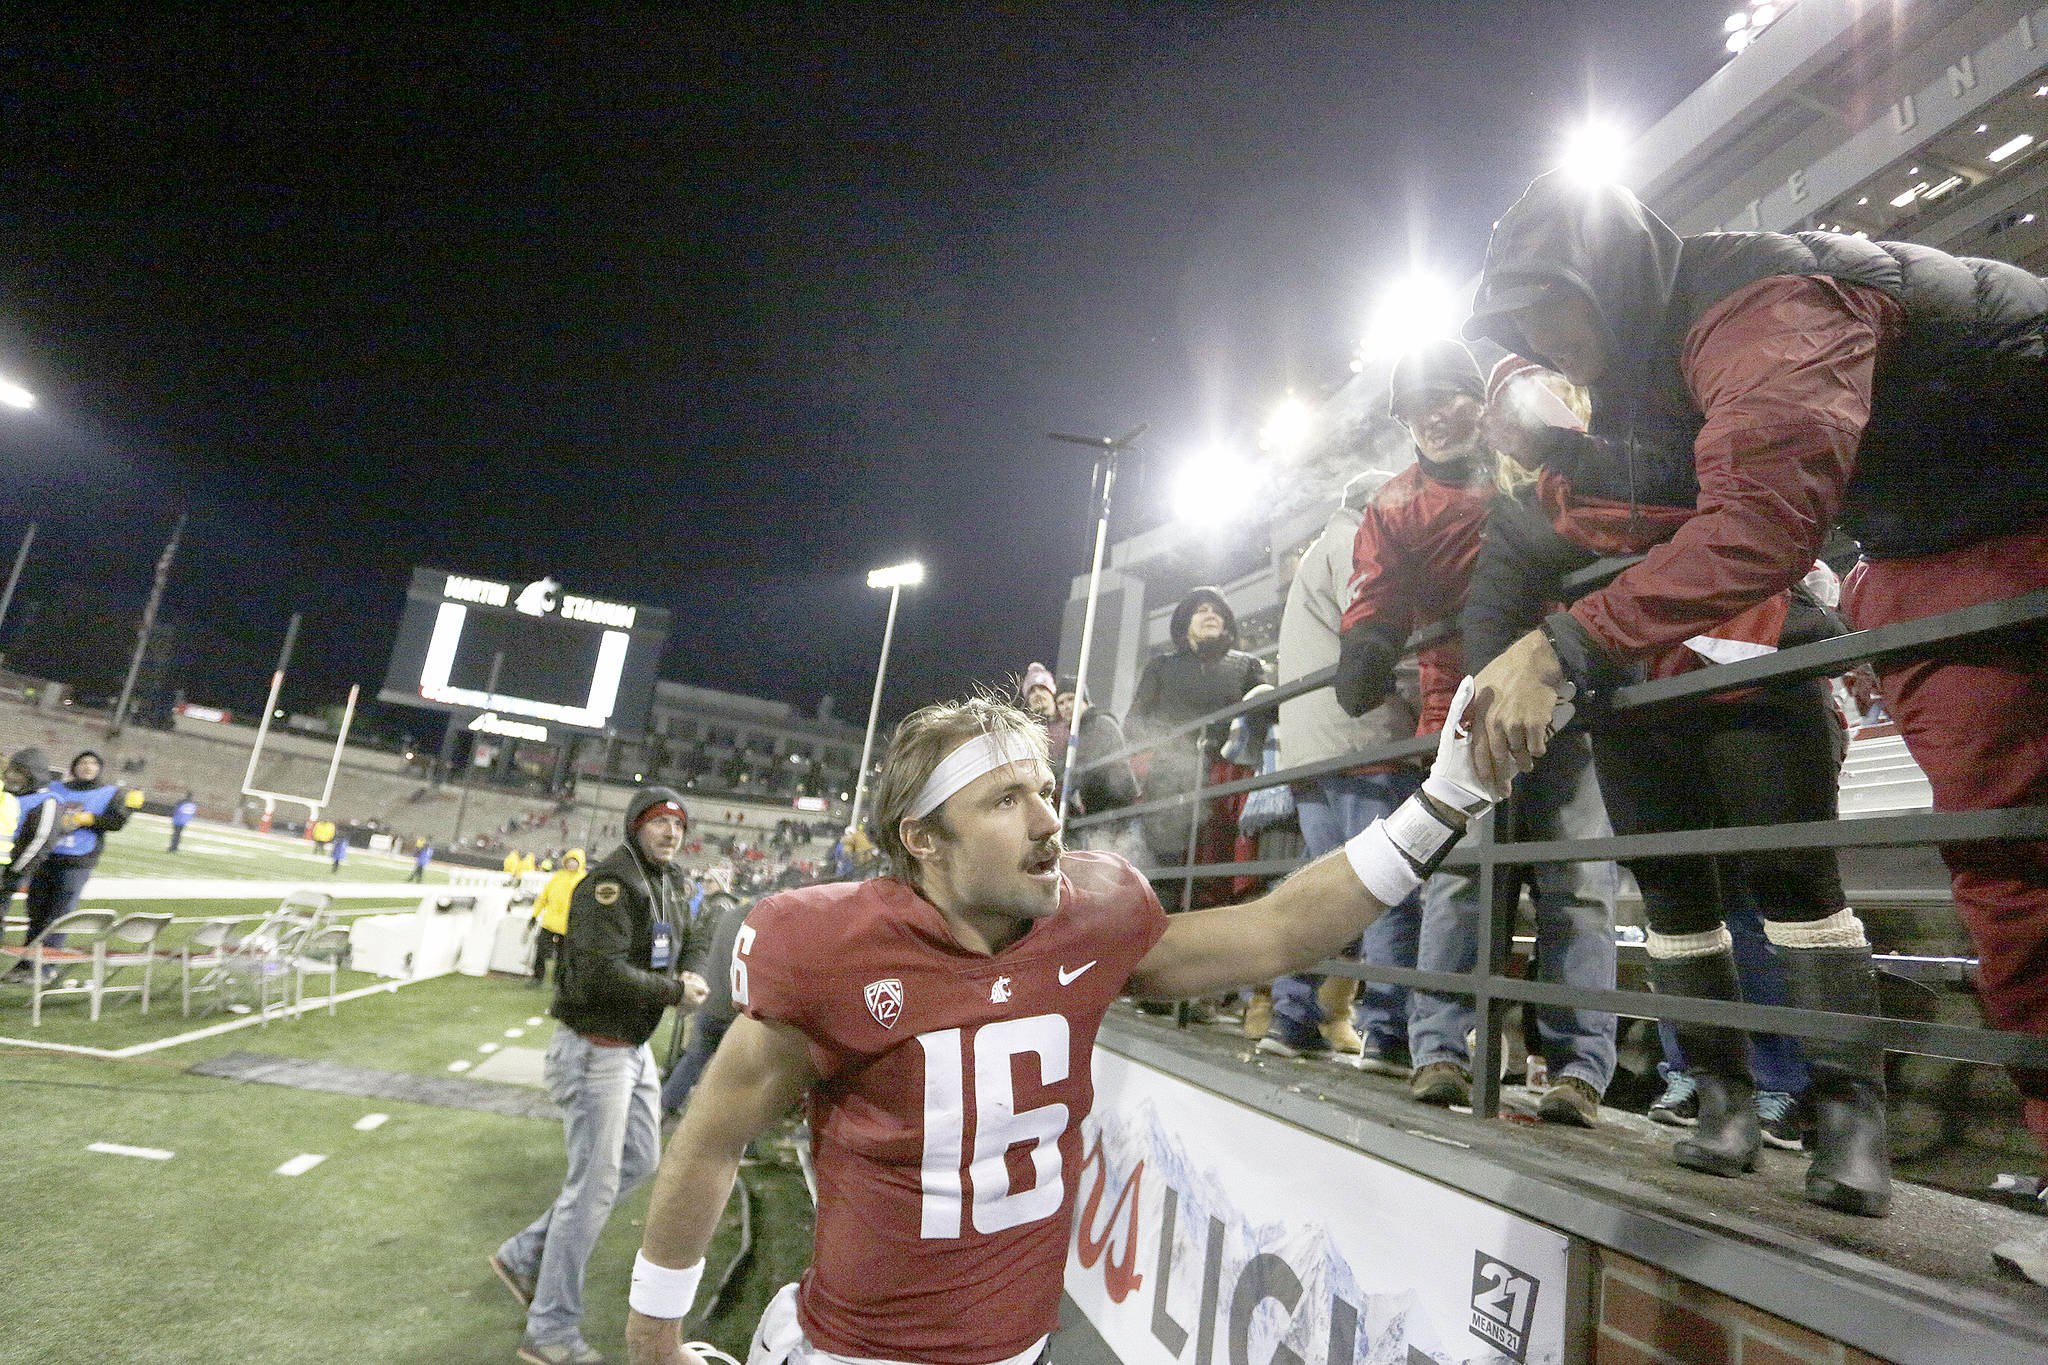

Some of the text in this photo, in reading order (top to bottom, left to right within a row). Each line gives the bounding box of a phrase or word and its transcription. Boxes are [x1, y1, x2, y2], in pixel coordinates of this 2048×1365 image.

[866, 981, 901, 1012] PAC
[878, 1000, 897, 1021] 12
[916, 1013, 1070, 1239] 16
[1150, 1185, 1440, 1365] LIG
[1473, 1261, 1532, 1334] 21
[1471, 1312, 1518, 1350] MEANS 21
